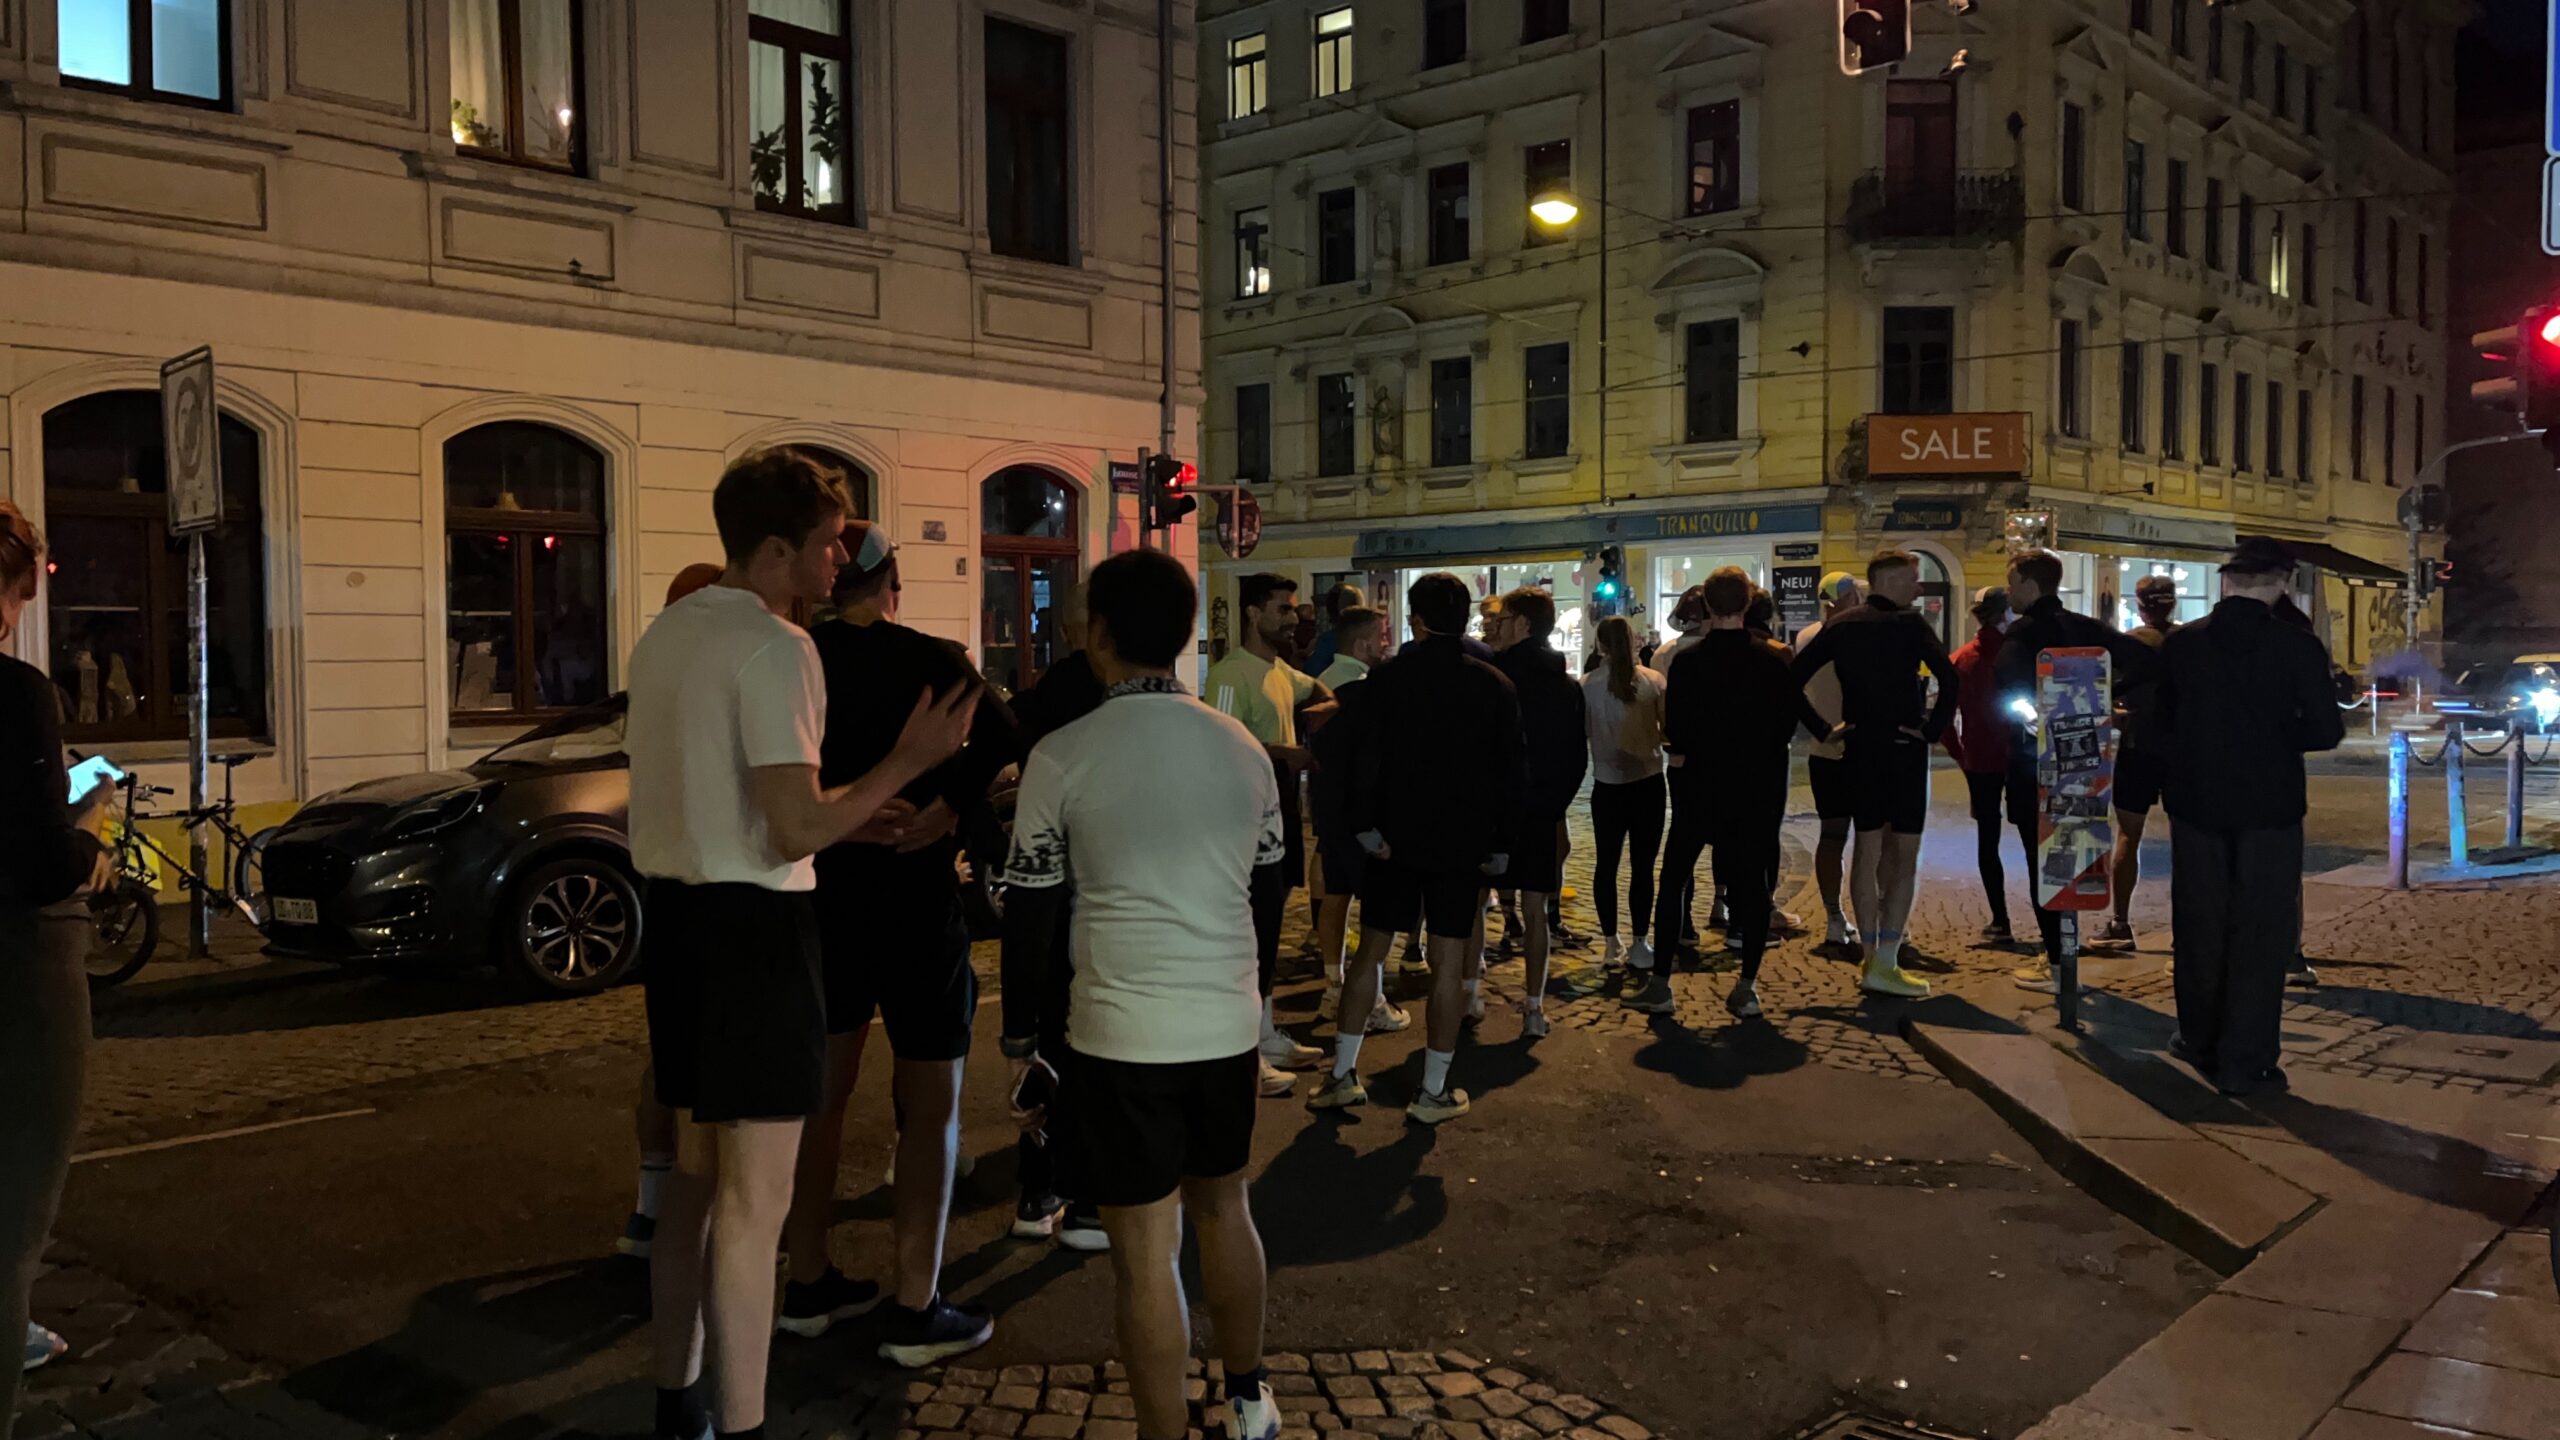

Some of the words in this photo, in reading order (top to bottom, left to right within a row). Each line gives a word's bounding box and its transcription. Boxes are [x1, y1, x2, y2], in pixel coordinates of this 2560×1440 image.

[1901, 427, 1992, 460] SALE
[1656, 510, 1759, 536] TRANQUILLO
[1781, 576, 1812, 589] NEU!
